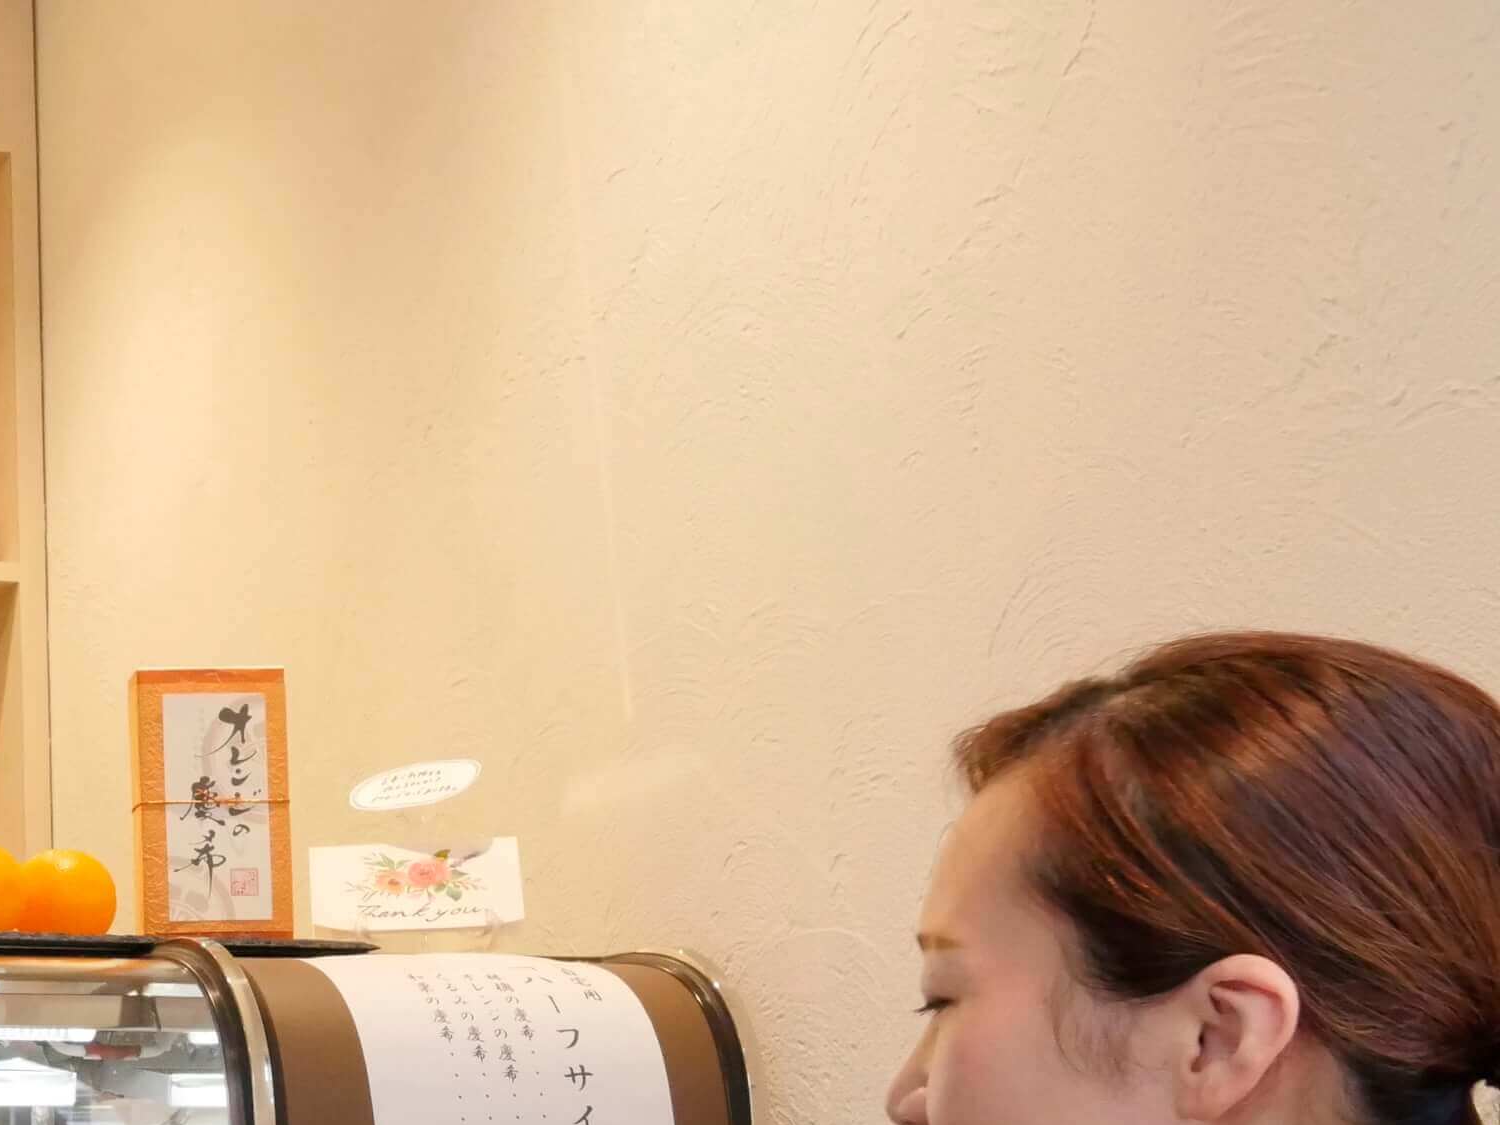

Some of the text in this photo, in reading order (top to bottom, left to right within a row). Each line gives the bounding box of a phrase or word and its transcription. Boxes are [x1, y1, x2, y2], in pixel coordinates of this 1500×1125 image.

[194, 703, 261, 837] オレンジの
[173, 775, 227, 897] 慶希
[356, 898, 485, 922] Thank you
